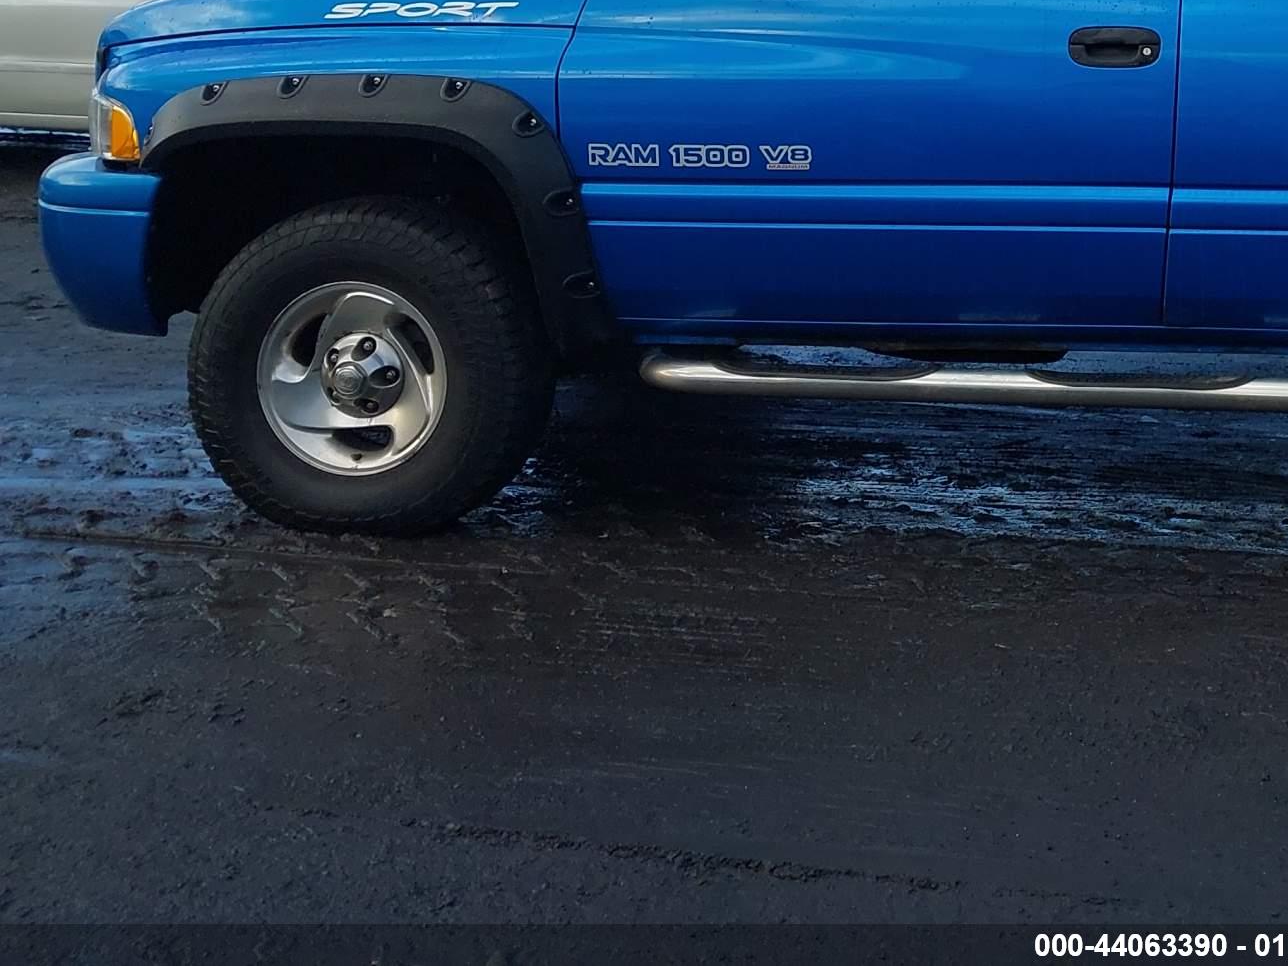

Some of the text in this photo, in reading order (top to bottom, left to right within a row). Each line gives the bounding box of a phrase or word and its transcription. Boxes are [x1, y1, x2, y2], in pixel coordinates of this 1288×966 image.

[323, 1, 520, 20] SPORT
[588, 143, 812, 168] RAM 1500 V8
